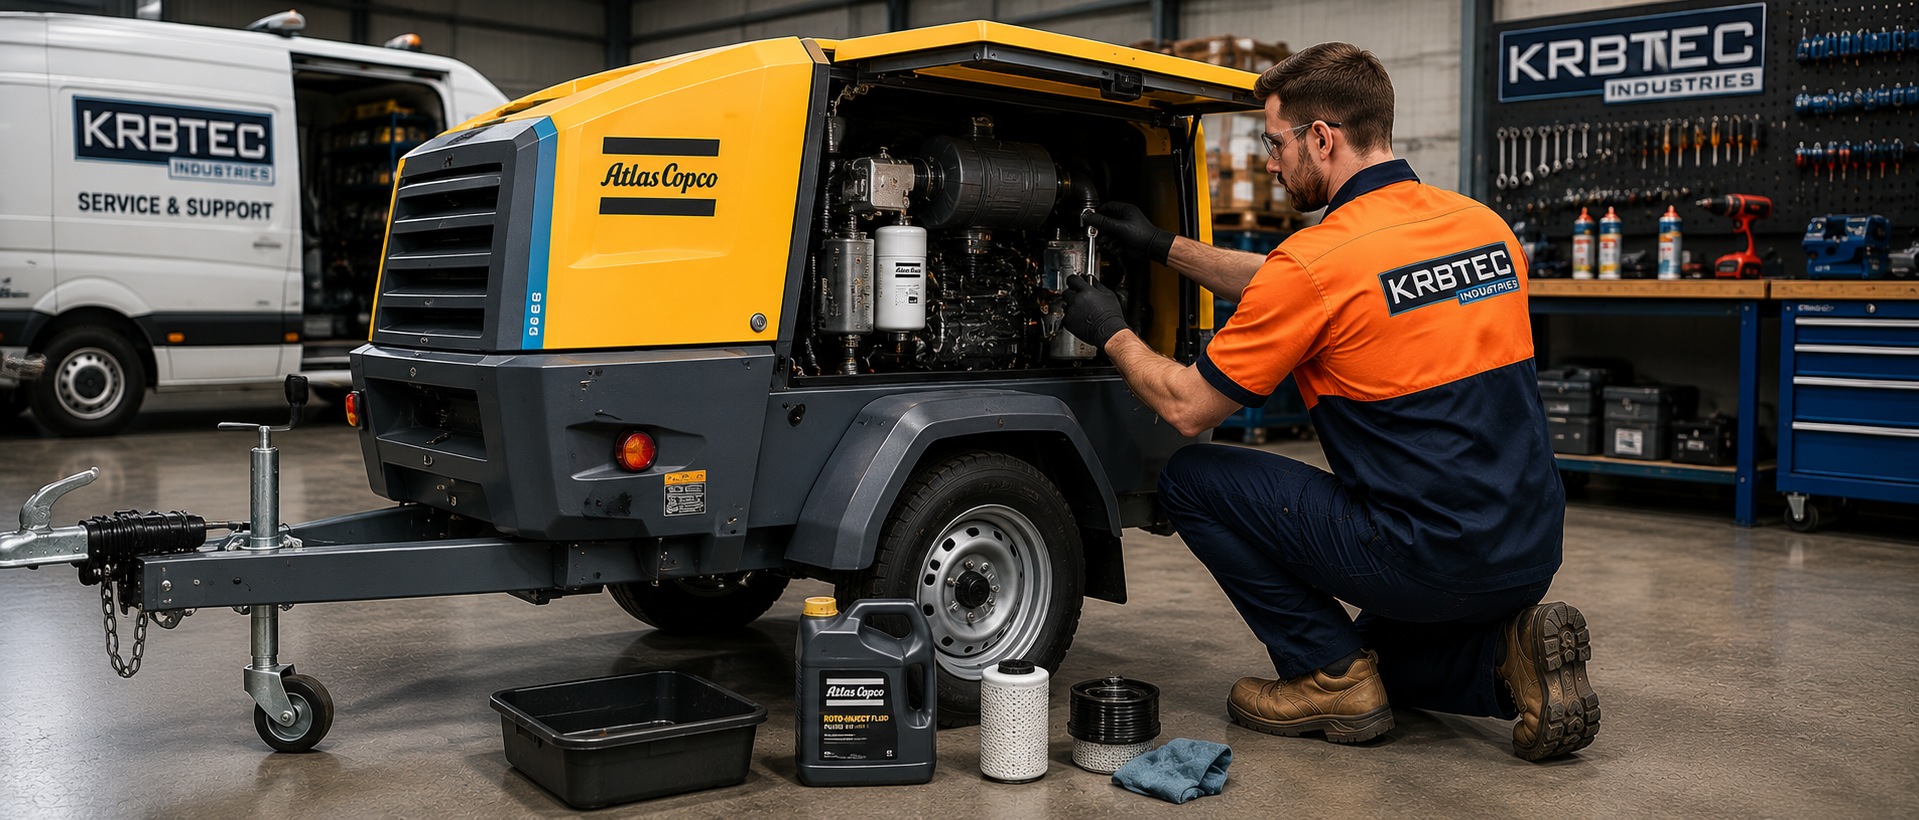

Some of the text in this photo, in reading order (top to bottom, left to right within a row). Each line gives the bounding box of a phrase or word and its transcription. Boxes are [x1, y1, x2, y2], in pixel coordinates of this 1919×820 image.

[1508, 21, 1754, 84] KRBTEC
[1610, 72, 1755, 97] INDUSTRIES
[82, 109, 266, 159] KRBTEC
[173, 161, 270, 181] INDUSTRIES
[600, 162, 719, 194] Atlas Copco
[78, 191, 274, 220] SERVICE & SUPPORT
[1387, 249, 1512, 305] KRBTEC
[826, 686, 885, 700] Atlas Copco
